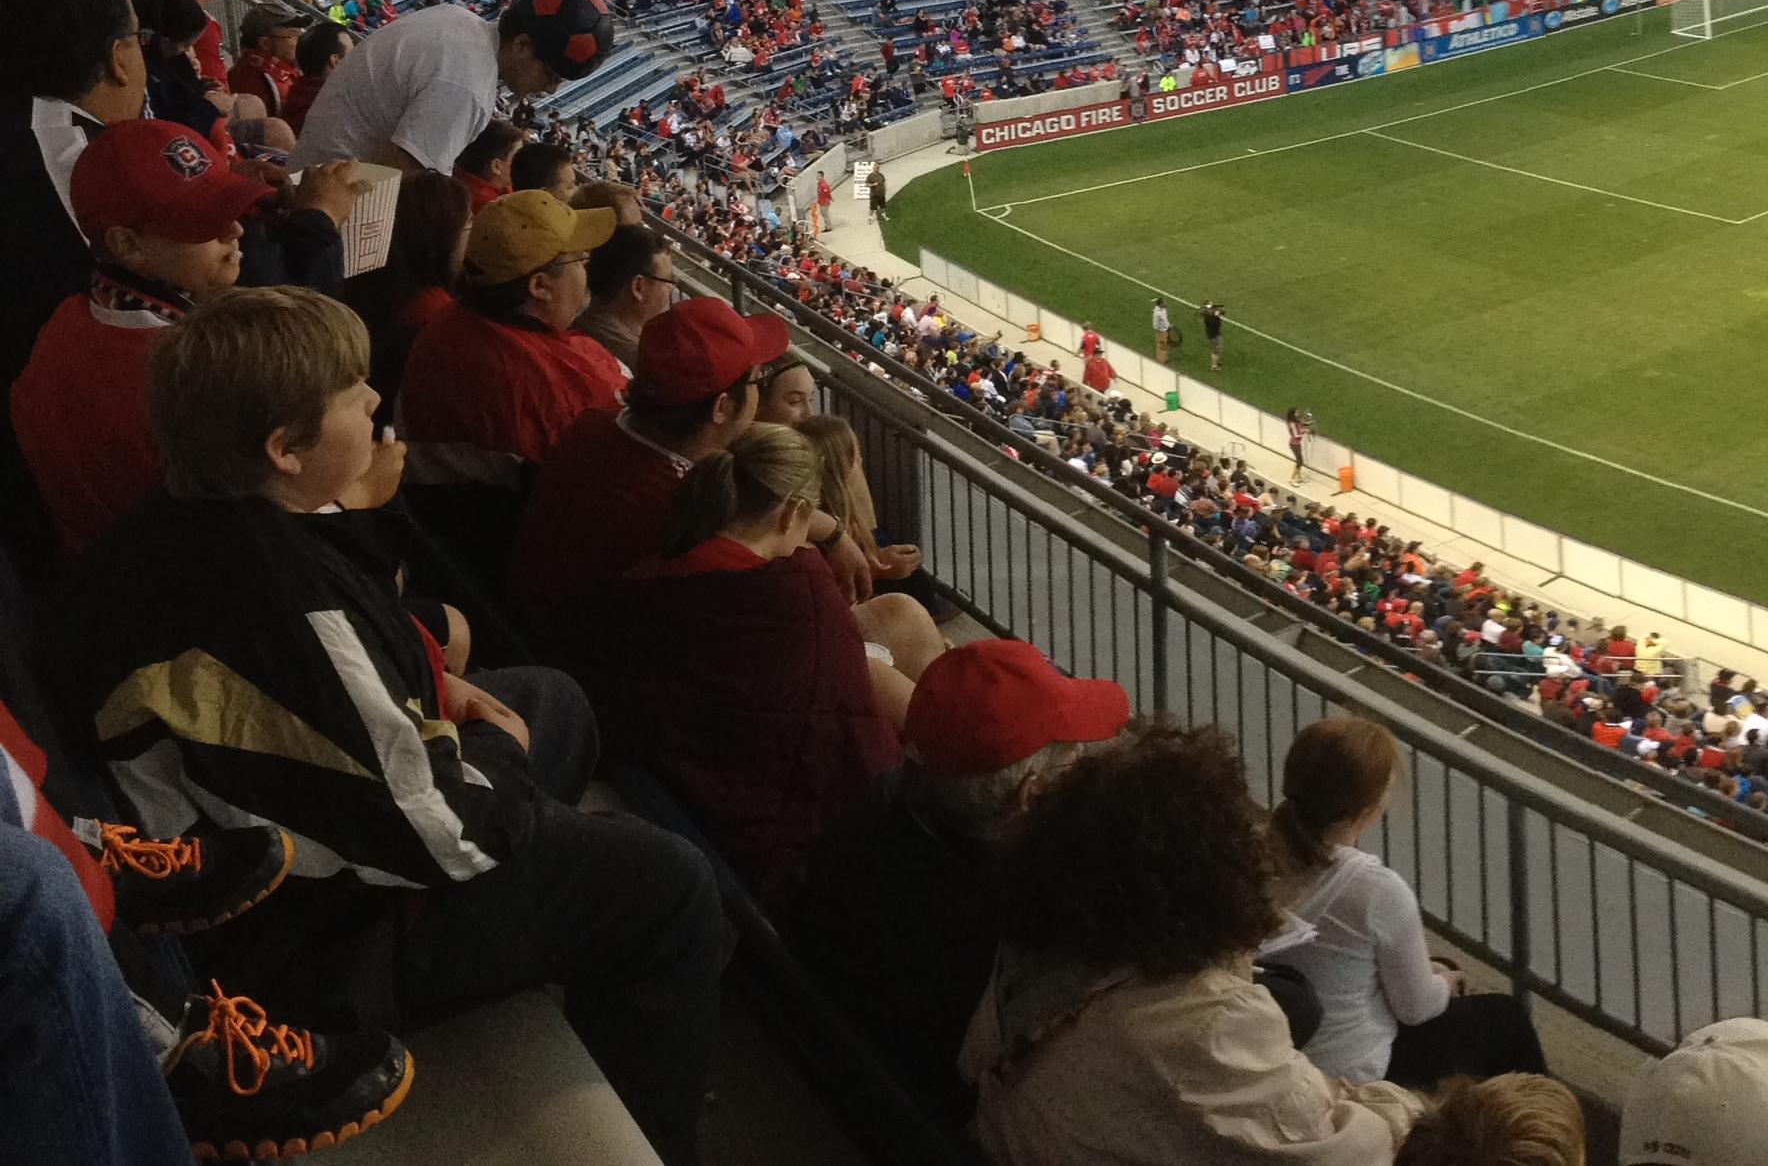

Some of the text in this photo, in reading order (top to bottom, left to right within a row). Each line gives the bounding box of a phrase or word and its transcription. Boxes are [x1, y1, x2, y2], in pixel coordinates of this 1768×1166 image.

[981, 75, 1280, 145] CHICAGO FIRE SOCCER CLUB
